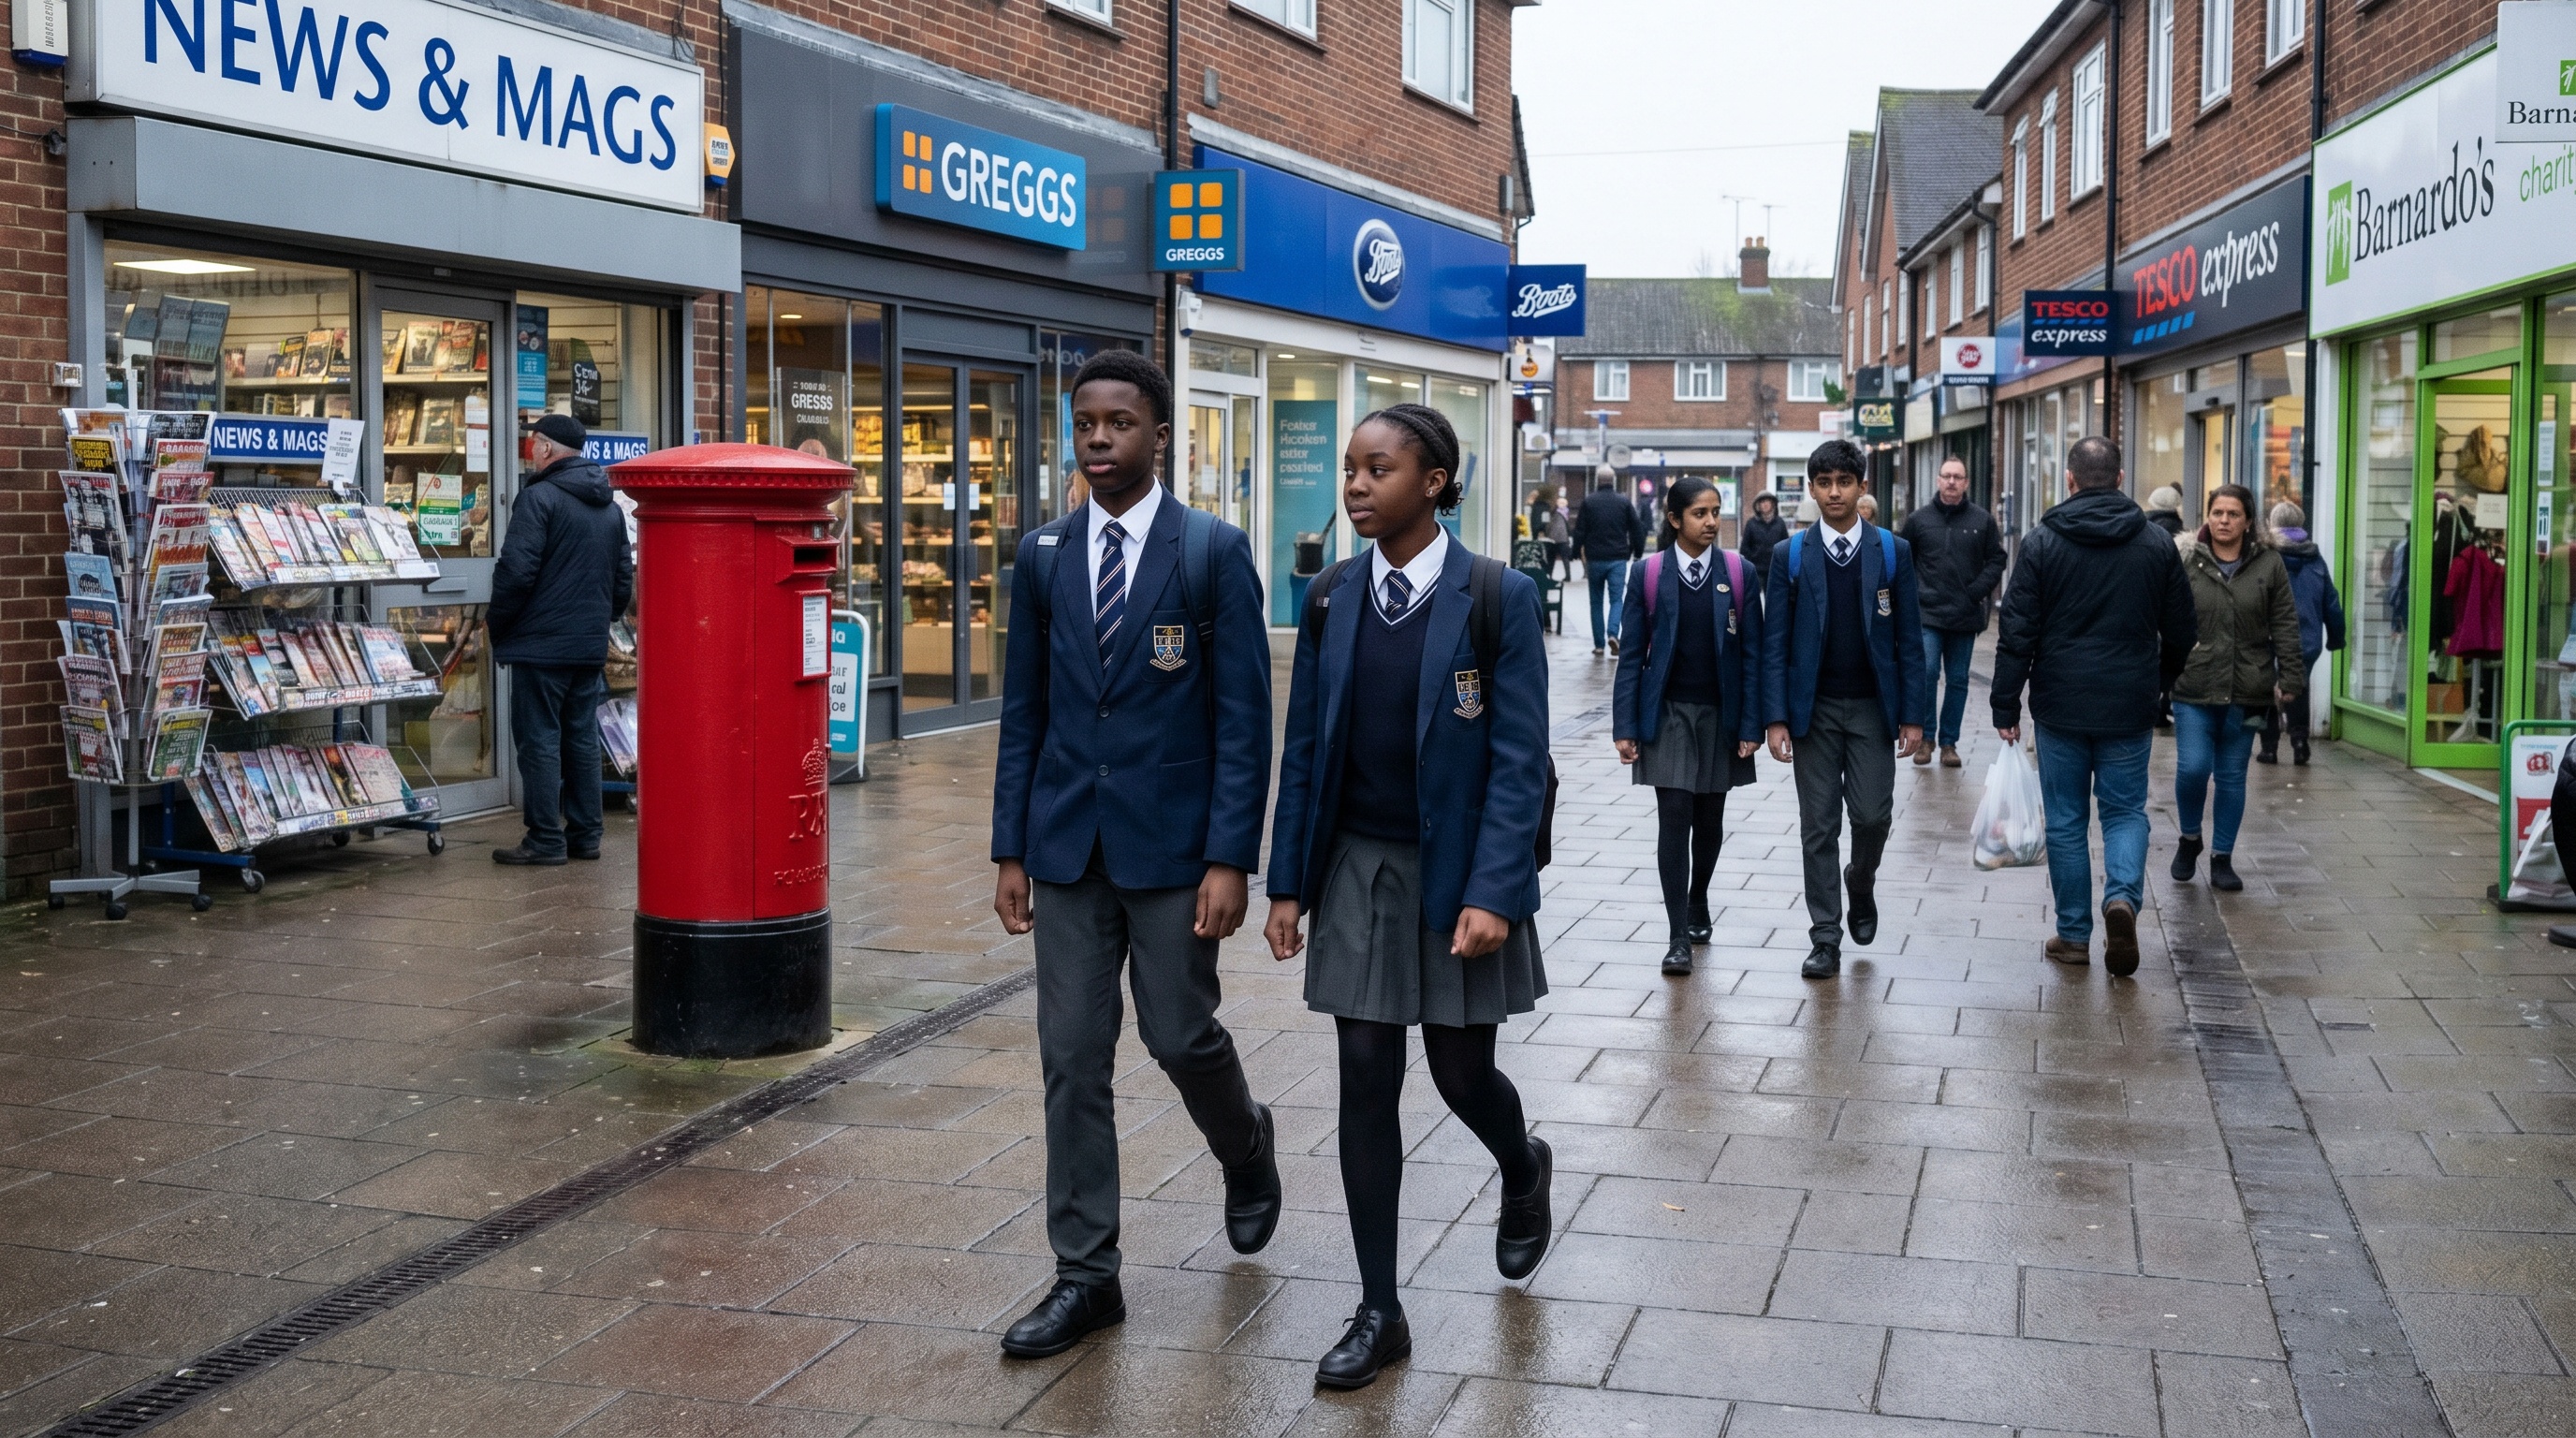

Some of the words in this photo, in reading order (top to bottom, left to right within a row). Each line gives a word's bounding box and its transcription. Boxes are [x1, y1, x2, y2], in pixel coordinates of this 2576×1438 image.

[144, 0, 390, 111] NEWS
[418, 37, 470, 130] &
[496, 55, 678, 171] MAGS
[2507, 101, 2576, 124] Barn
[941, 141, 1076, 227] GREGGS
[2354, 137, 2495, 262] Barnardo's
[2520, 144, 2576, 203] charit
[1165, 247, 1224, 261] GREGGS
[1365, 239, 1402, 286] Boots
[2133, 245, 2197, 318] TESCO
[2202, 221, 2279, 308] express
[1513, 283, 1576, 318] Boots
[2031, 301, 2109, 317] TESCO
[2031, 328, 2108, 347] express
[214, 427, 262, 449] NEWS
[267, 429, 278, 450] &
[283, 430, 328, 452] MAGS
[603, 442, 611, 460] &
[614, 442, 647, 461] MAGS
